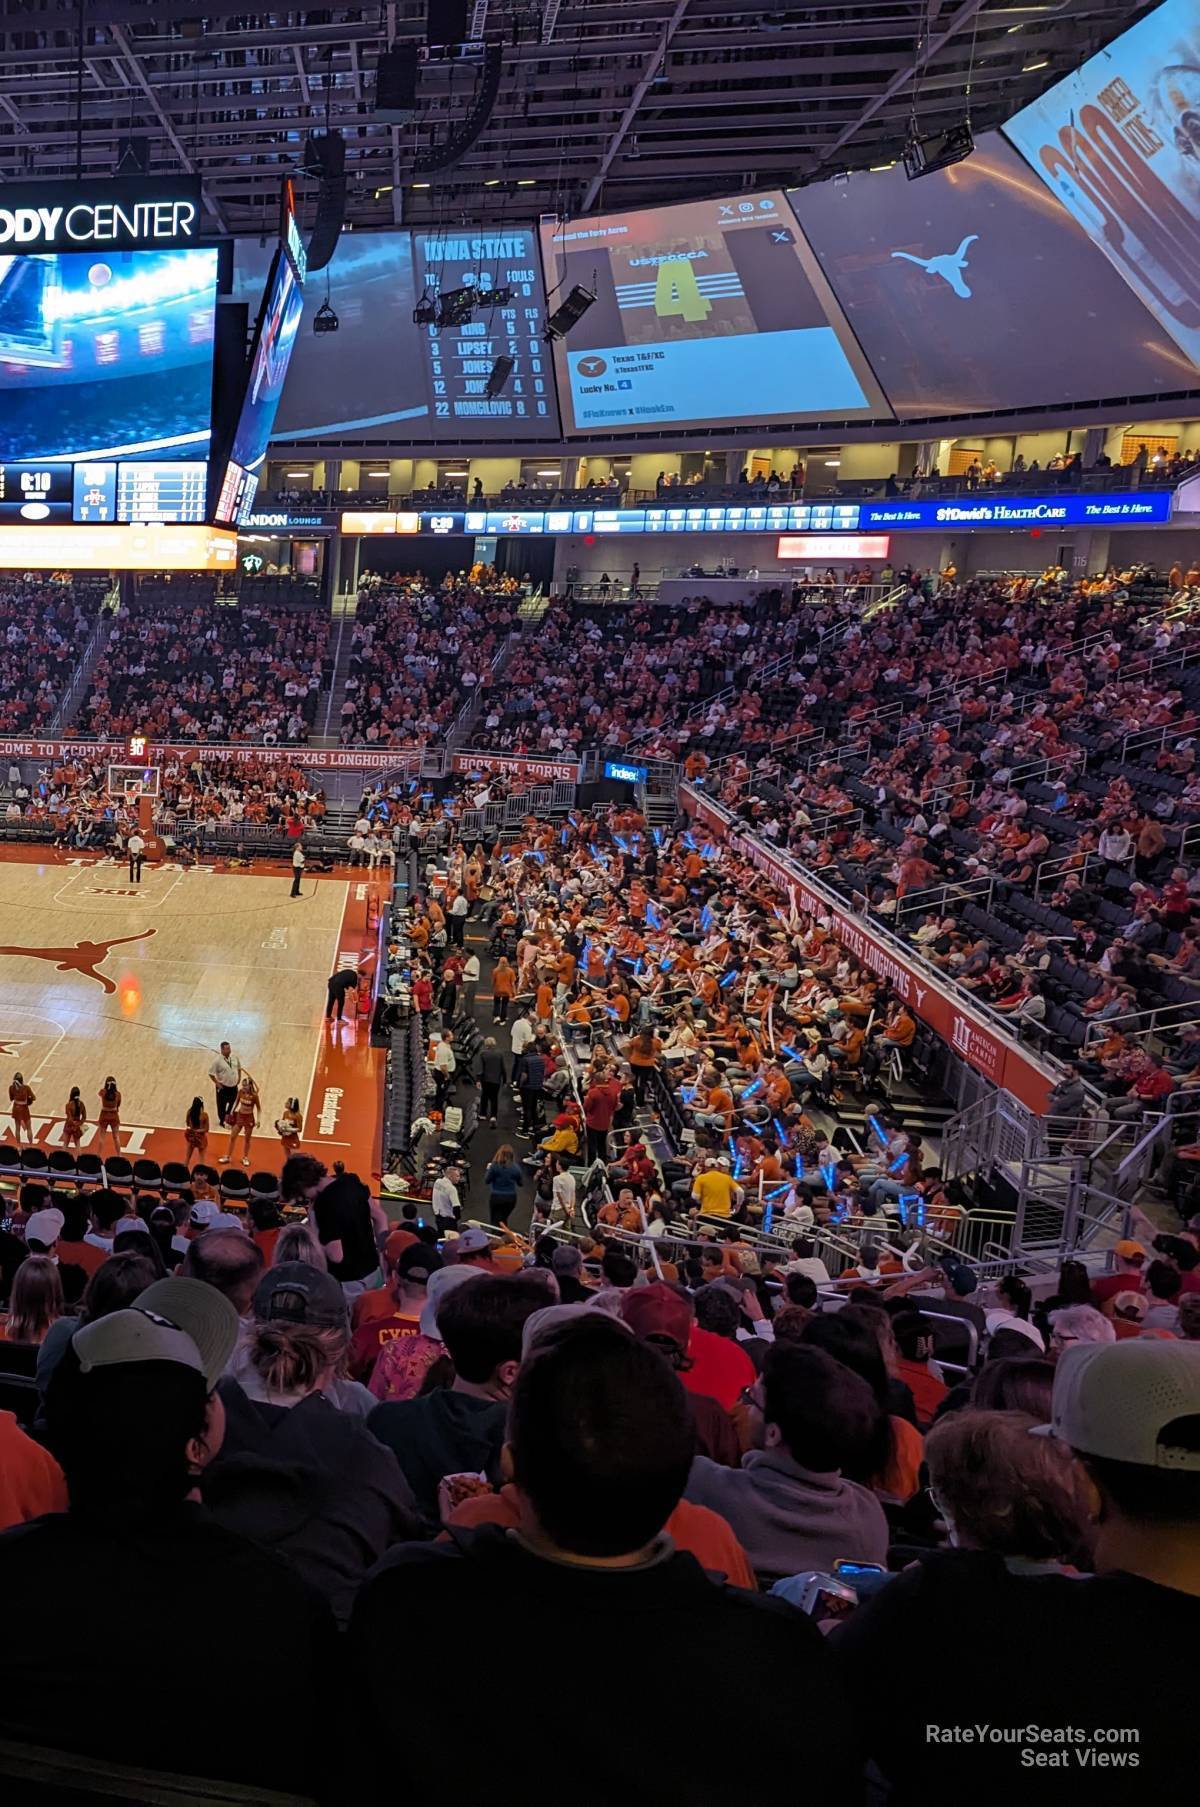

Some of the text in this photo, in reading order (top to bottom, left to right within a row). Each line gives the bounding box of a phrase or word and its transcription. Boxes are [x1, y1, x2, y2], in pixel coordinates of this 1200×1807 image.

[65, 201, 195, 240] CENTER
[424, 238, 525, 261] IOWA STATE
[522, 284, 530, 296] 0
[655, 259, 712, 322] 4
[501, 308, 538, 319] PTS FLS
[507, 321, 515, 335] 5
[529, 321, 536, 334] 1
[431, 340, 539, 356] 3 LIPSEY 2 0
[433, 361, 441, 374] 5
[462, 360, 493, 374] JONES
[533, 359, 541, 373] 0
[612, 355, 635, 363] Texas
[433, 379, 543, 394] 12 JONE 4 0
[580, 385, 602, 394] Lucky
[604, 384, 617, 392] No.
[436, 402, 449, 416] 22
[454, 401, 512, 416] MOMCILOVIC
[538, 401, 546, 415] 0
[20, 472, 51, 491] 6:10
[870, 512, 882, 521] The
[883, 512, 897, 521] Best
[1086, 505, 1101, 515] The
[1102, 505, 1119, 514] Best
[288, 517, 322, 525] LOUNGE
[39, 745, 54, 755] TO
[110, 747, 164, 758] CEER
[199, 750, 406, 767] HOME OF THE TEXAS LONGHORNS
[459, 758, 492, 770] HOOK
[527, 764, 570, 779] HORNS
[841, 922, 863, 957] TEXAS
[864, 942, 910, 998] LONGHORNS
[971, 1032, 997, 1056] AMERICAN
[970, 1042, 996, 1068] CAMPUS
